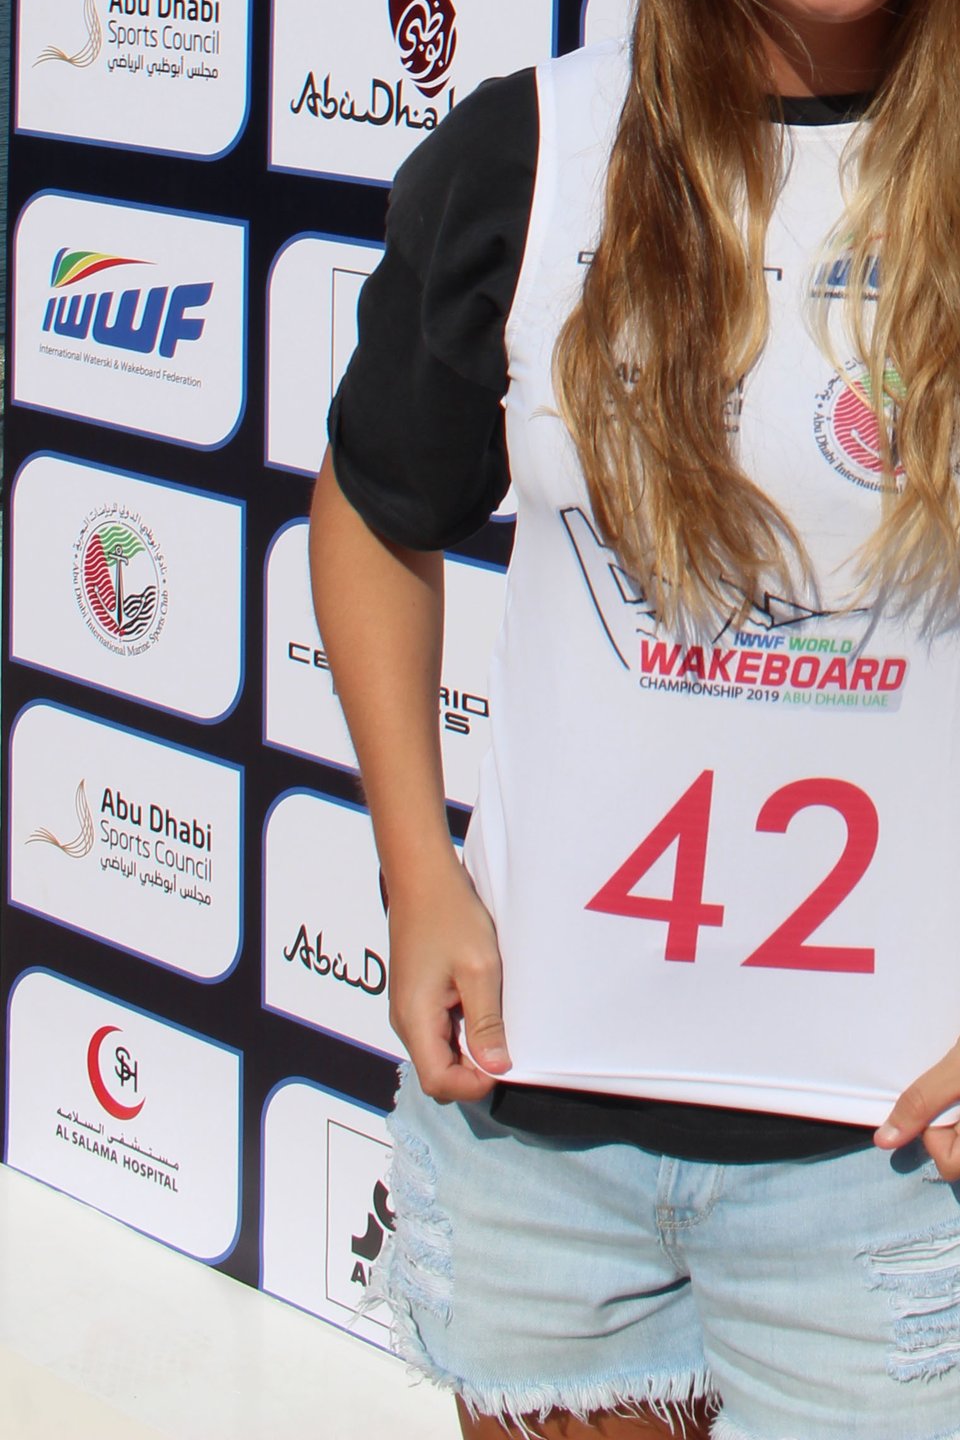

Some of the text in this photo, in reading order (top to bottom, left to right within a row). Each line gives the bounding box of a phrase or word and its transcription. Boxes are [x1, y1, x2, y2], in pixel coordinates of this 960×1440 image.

[108, 20, 219, 54] Sports Council
[39, 344, 82, 361] International
[162, 370, 201, 387] Federation
[641, 638, 907, 691] WAKEBOARD
[734, 632, 853, 653] IWWF WORLD
[640, 676, 889, 707] CHAMPIONSHIP 2019 ABU DHABI UAE
[101, 788, 211, 852] Abu Dhabi
[100, 820, 211, 882] Sports Council
[584, 769, 879, 974] 42
[56, 1124, 178, 1192] AL SALAMA HOSPITAL
